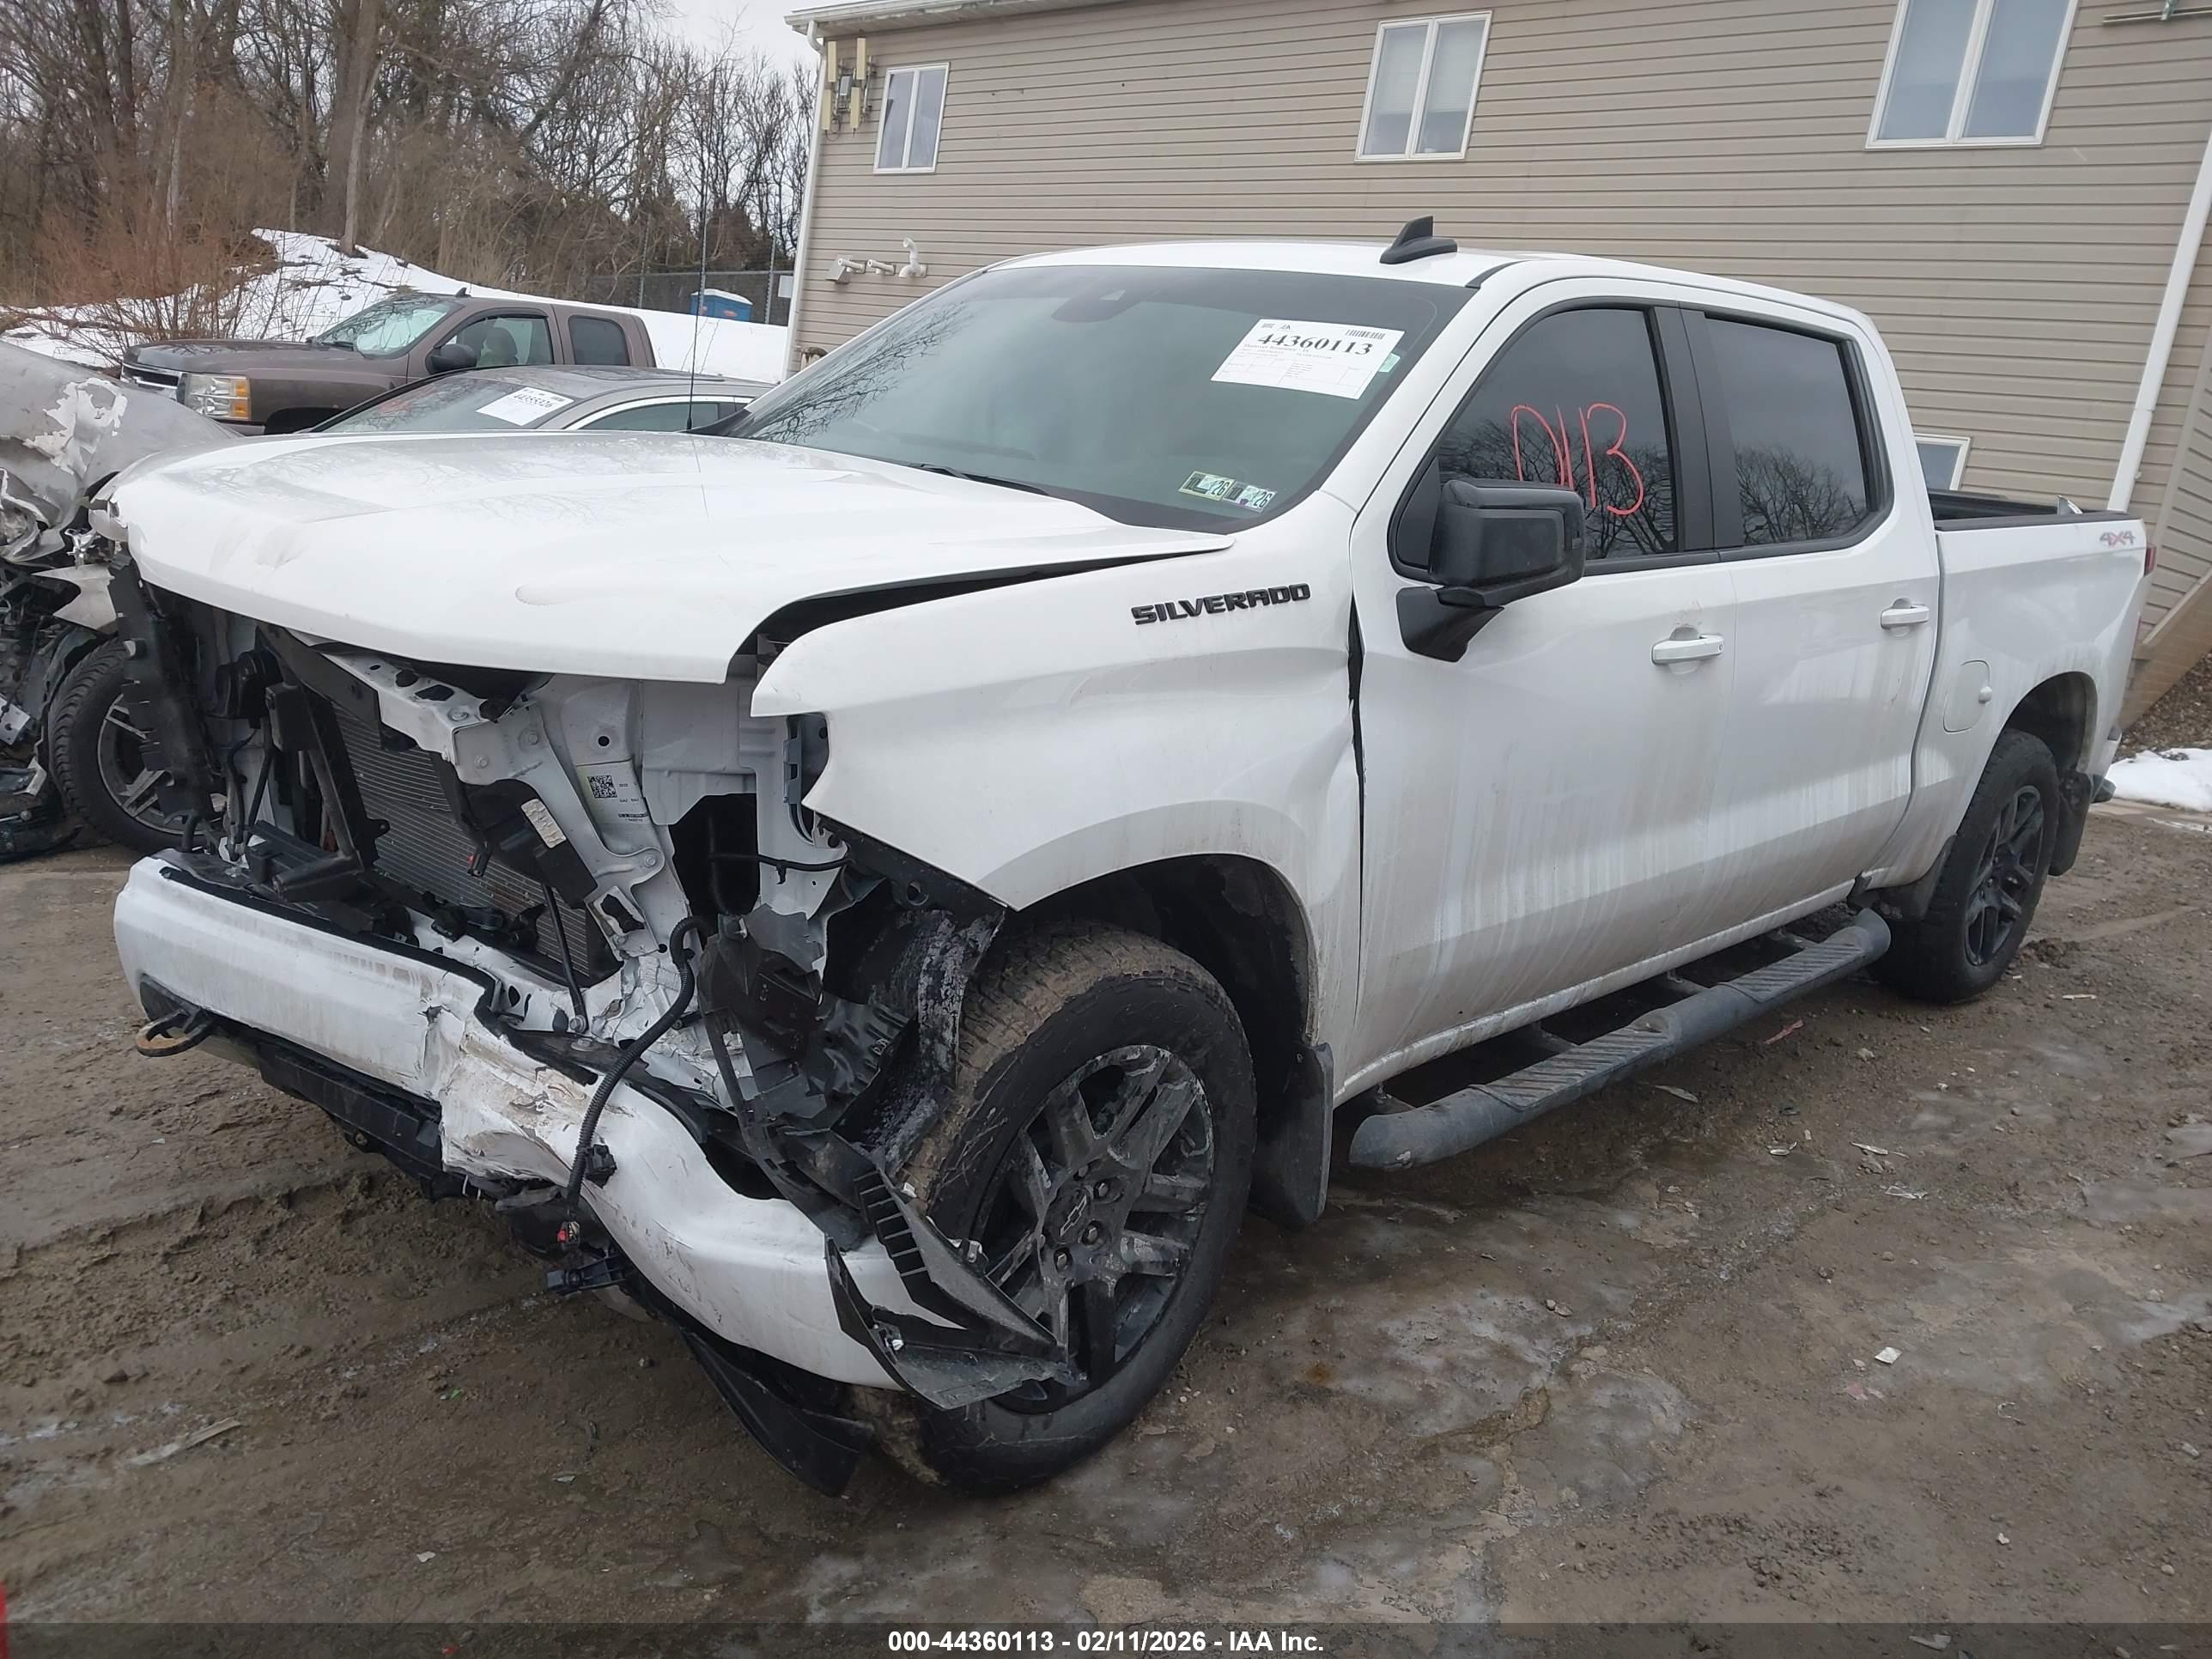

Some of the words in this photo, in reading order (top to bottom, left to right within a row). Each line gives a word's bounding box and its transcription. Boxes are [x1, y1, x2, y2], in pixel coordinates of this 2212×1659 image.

[1257, 332, 1374, 356] 44360113
[1253, 491, 1273, 508] 26
[1131, 582, 1312, 625] SILVERADO
